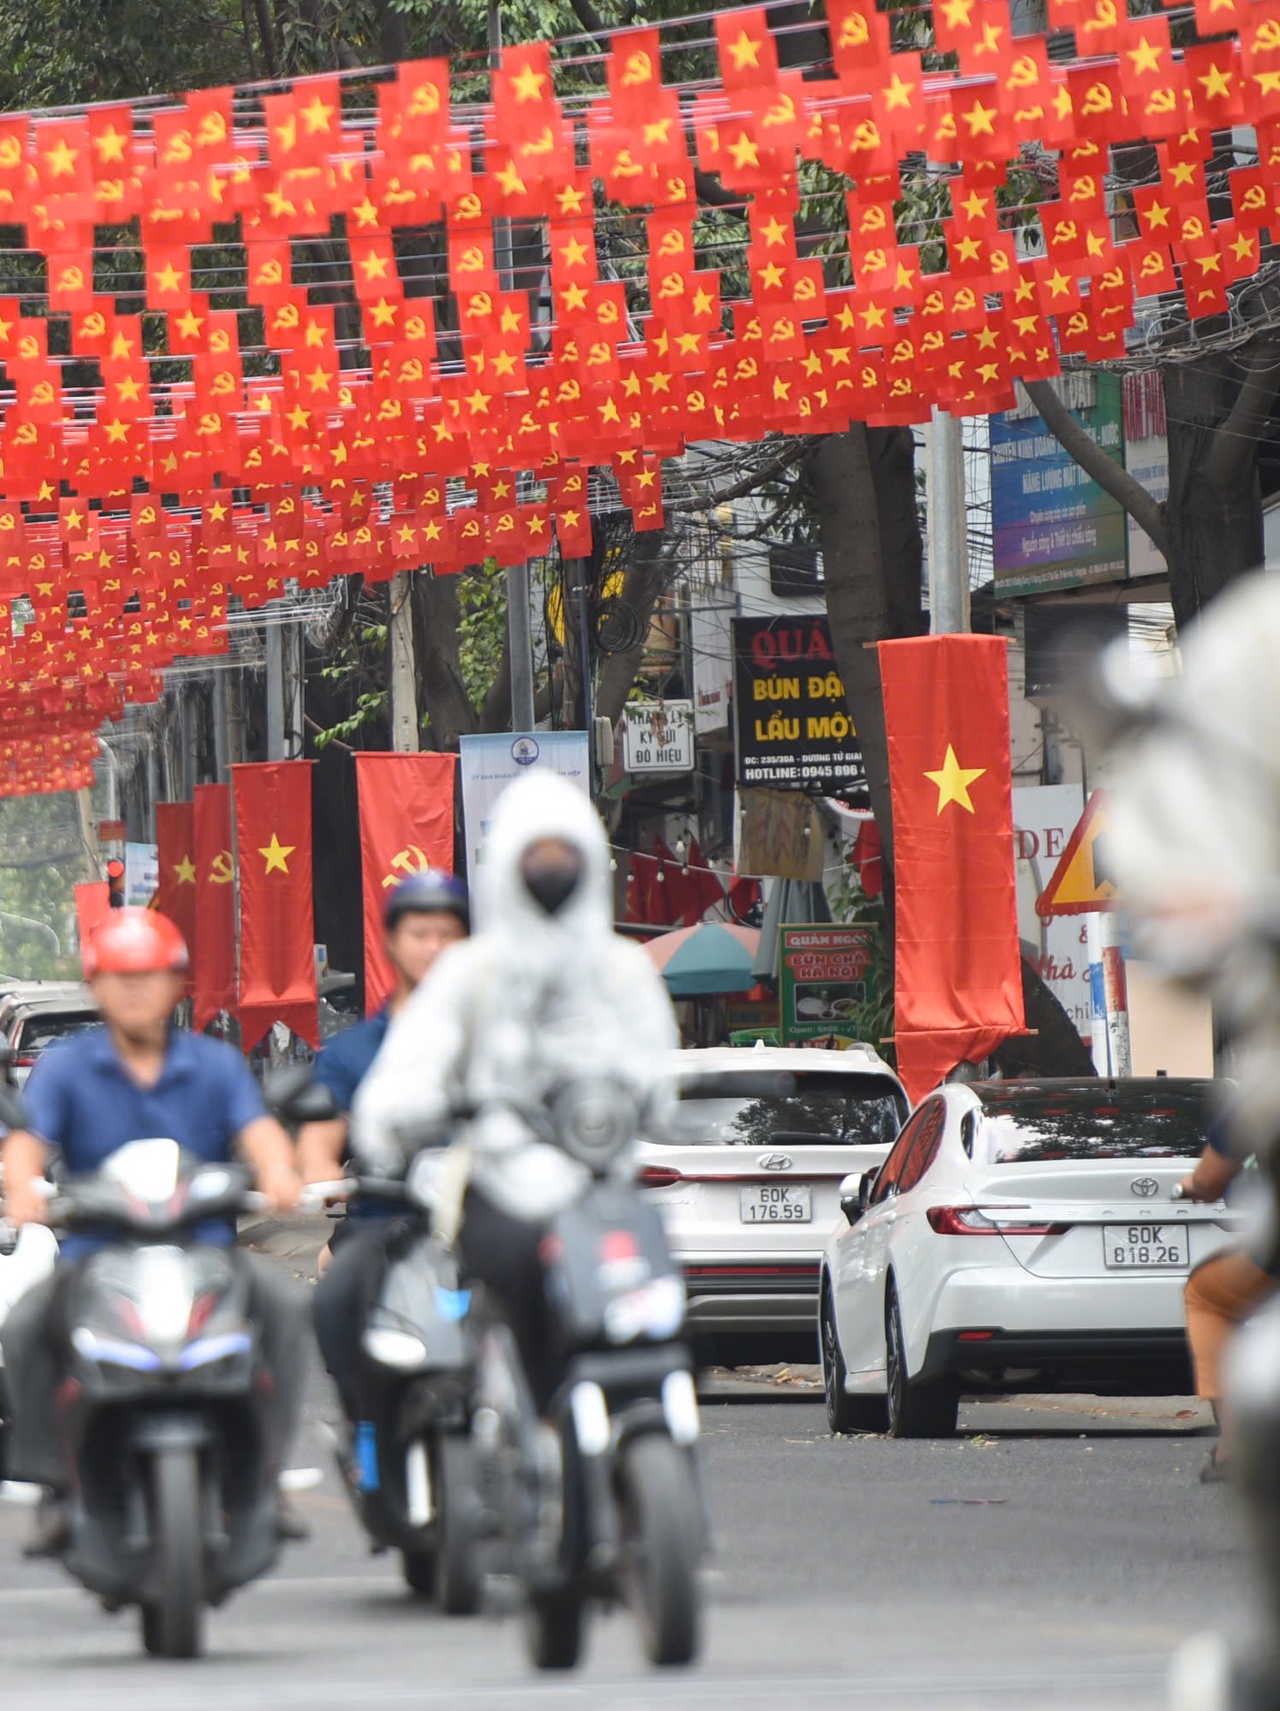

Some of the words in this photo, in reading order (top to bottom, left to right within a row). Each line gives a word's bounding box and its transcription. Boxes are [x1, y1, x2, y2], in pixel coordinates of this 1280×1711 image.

[752, 618, 835, 669] QUÁ
[753, 673, 800, 701] BÚN
[807, 671, 845, 703] ĐẬ
[756, 709, 800, 742] LẨU
[761, 755, 795, 764] 235/30A
[745, 767, 801, 780] HOTLINE:
[802, 765, 832, 778] 0945
[834, 765, 858, 776] 896
[760, 1188, 790, 1203] 60K
[750, 1204, 803, 1219] 176.59
[1128, 1226, 1163, 1244] 60K
[1114, 1247, 1179, 1263] 818.26
